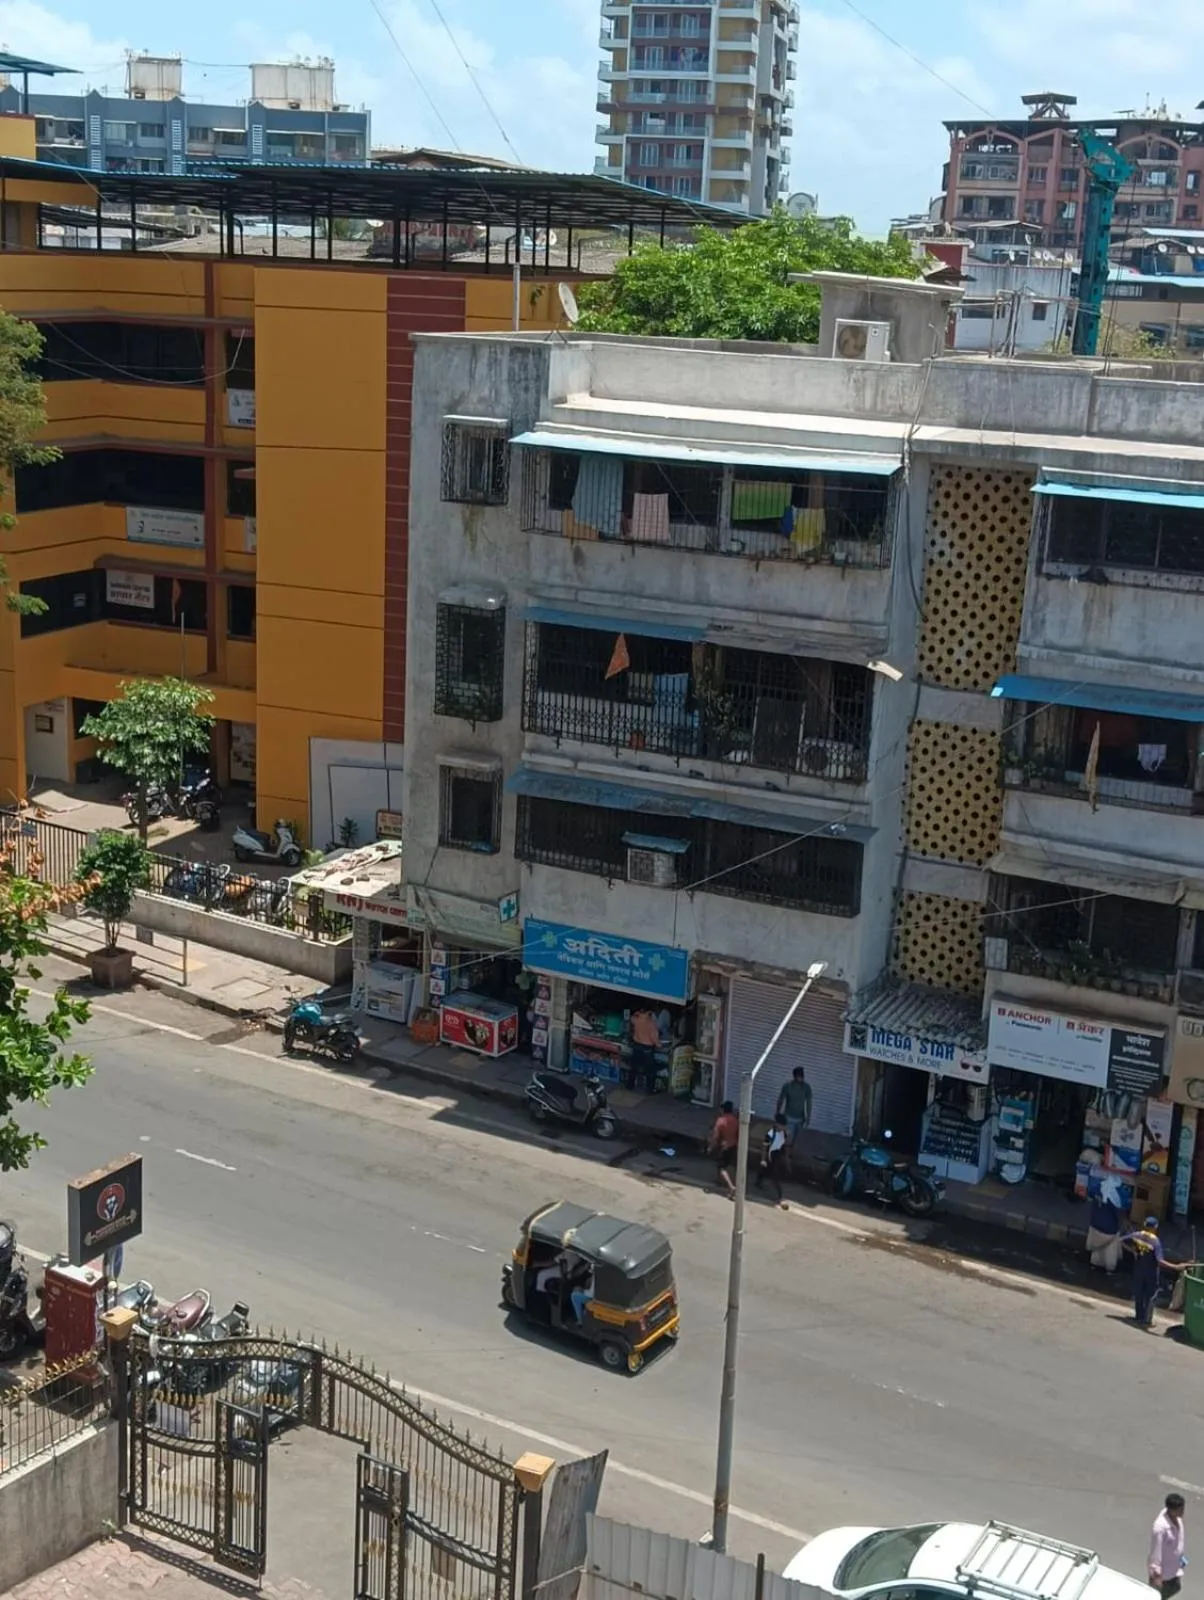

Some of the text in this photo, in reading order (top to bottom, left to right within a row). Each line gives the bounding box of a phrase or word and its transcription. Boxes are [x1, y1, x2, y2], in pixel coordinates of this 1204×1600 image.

[562, 937, 644, 967] अदिती
[1008, 1008, 1052, 1025] ANCHOR
[871, 1027, 956, 1061] MEGA STAR
[869, 1046, 943, 1069] WATCHES & MORE
